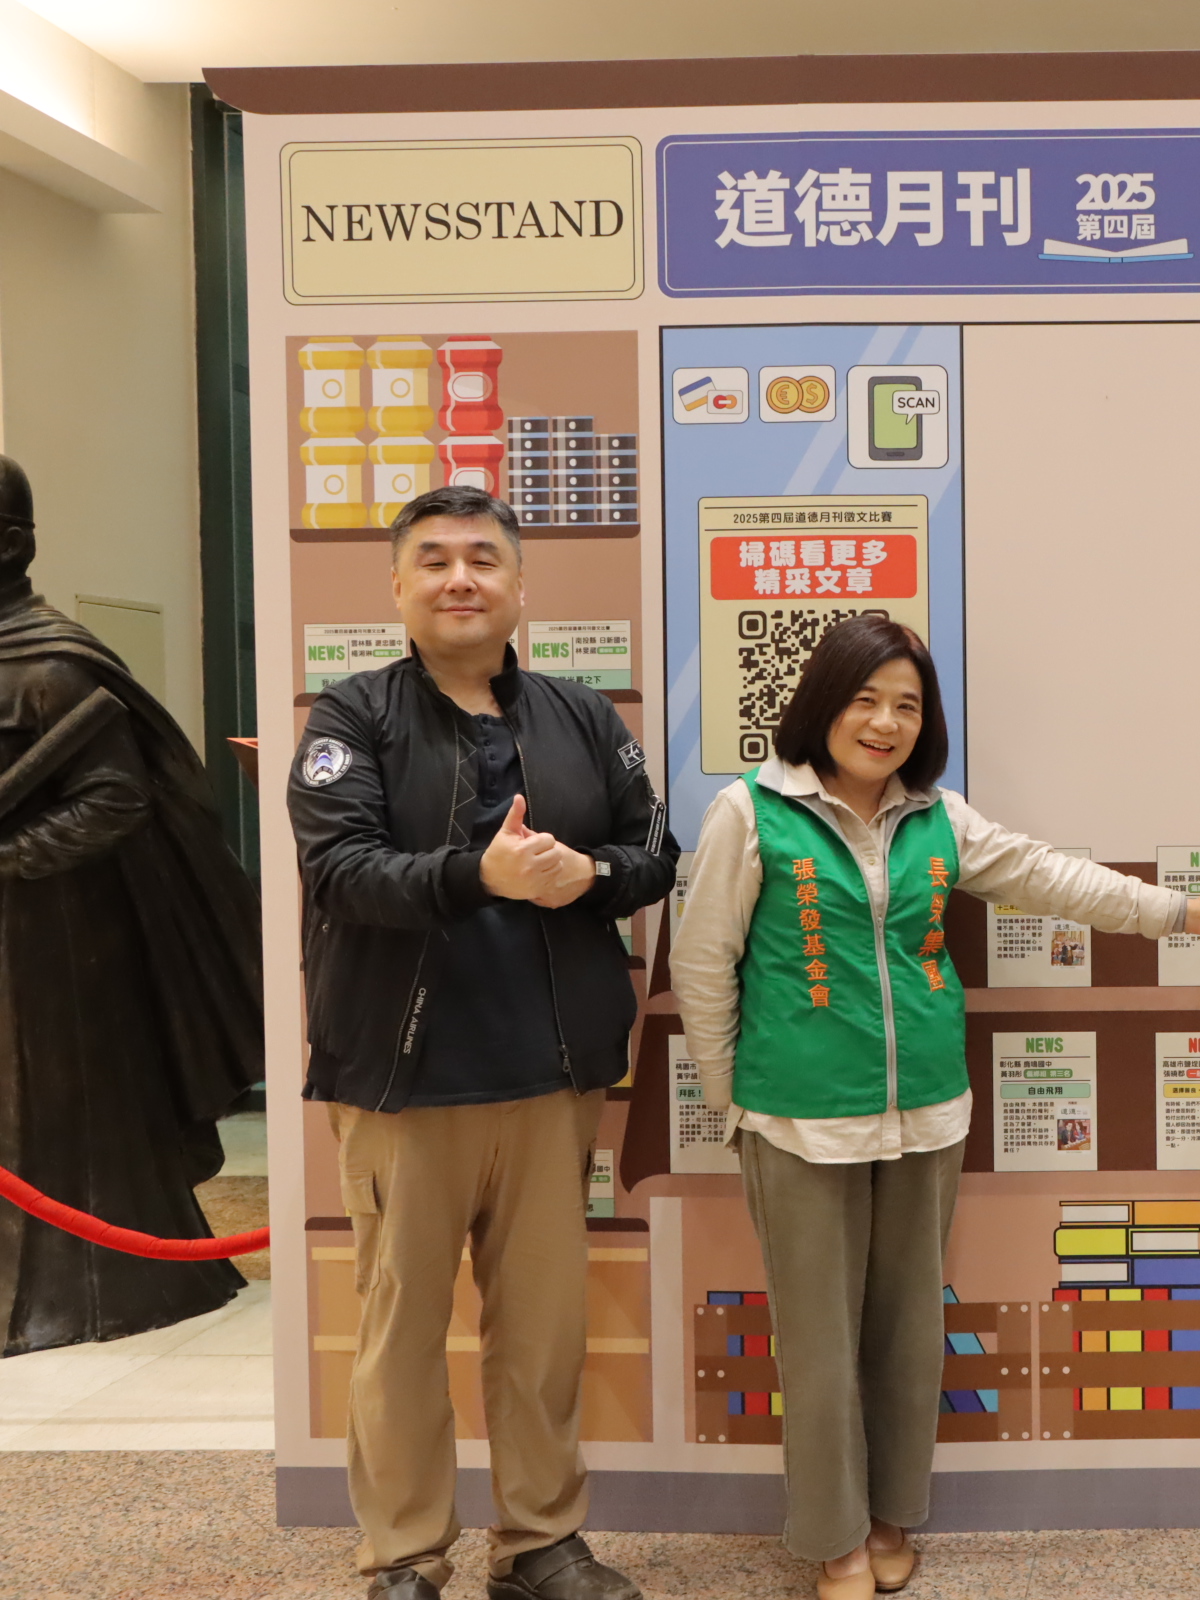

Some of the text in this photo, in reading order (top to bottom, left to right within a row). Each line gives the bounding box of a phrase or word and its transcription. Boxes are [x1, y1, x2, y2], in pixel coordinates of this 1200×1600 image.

[1075, 172, 1155, 211] 2025
[715, 166, 1031, 249] 道德月刊
[301, 200, 624, 243] NEWSSTAND
[1076, 213, 1155, 241] 第四屆
[897, 395, 935, 408] SCAN
[733, 511, 893, 524] 2025第四屆道德月刊徵文比賽
[739, 540, 888, 567] 掃碼看更多
[754, 567, 873, 594] 精采文章
[308, 645, 345, 661] NEWS
[532, 642, 569, 658] NEWS
[792, 857, 831, 1007] 張榮發基金會
[918, 856, 949, 992] 長榮集團
[1025, 1037, 1064, 1053] NEWS
[1028, 1086, 1063, 1095] 自由飛翔
